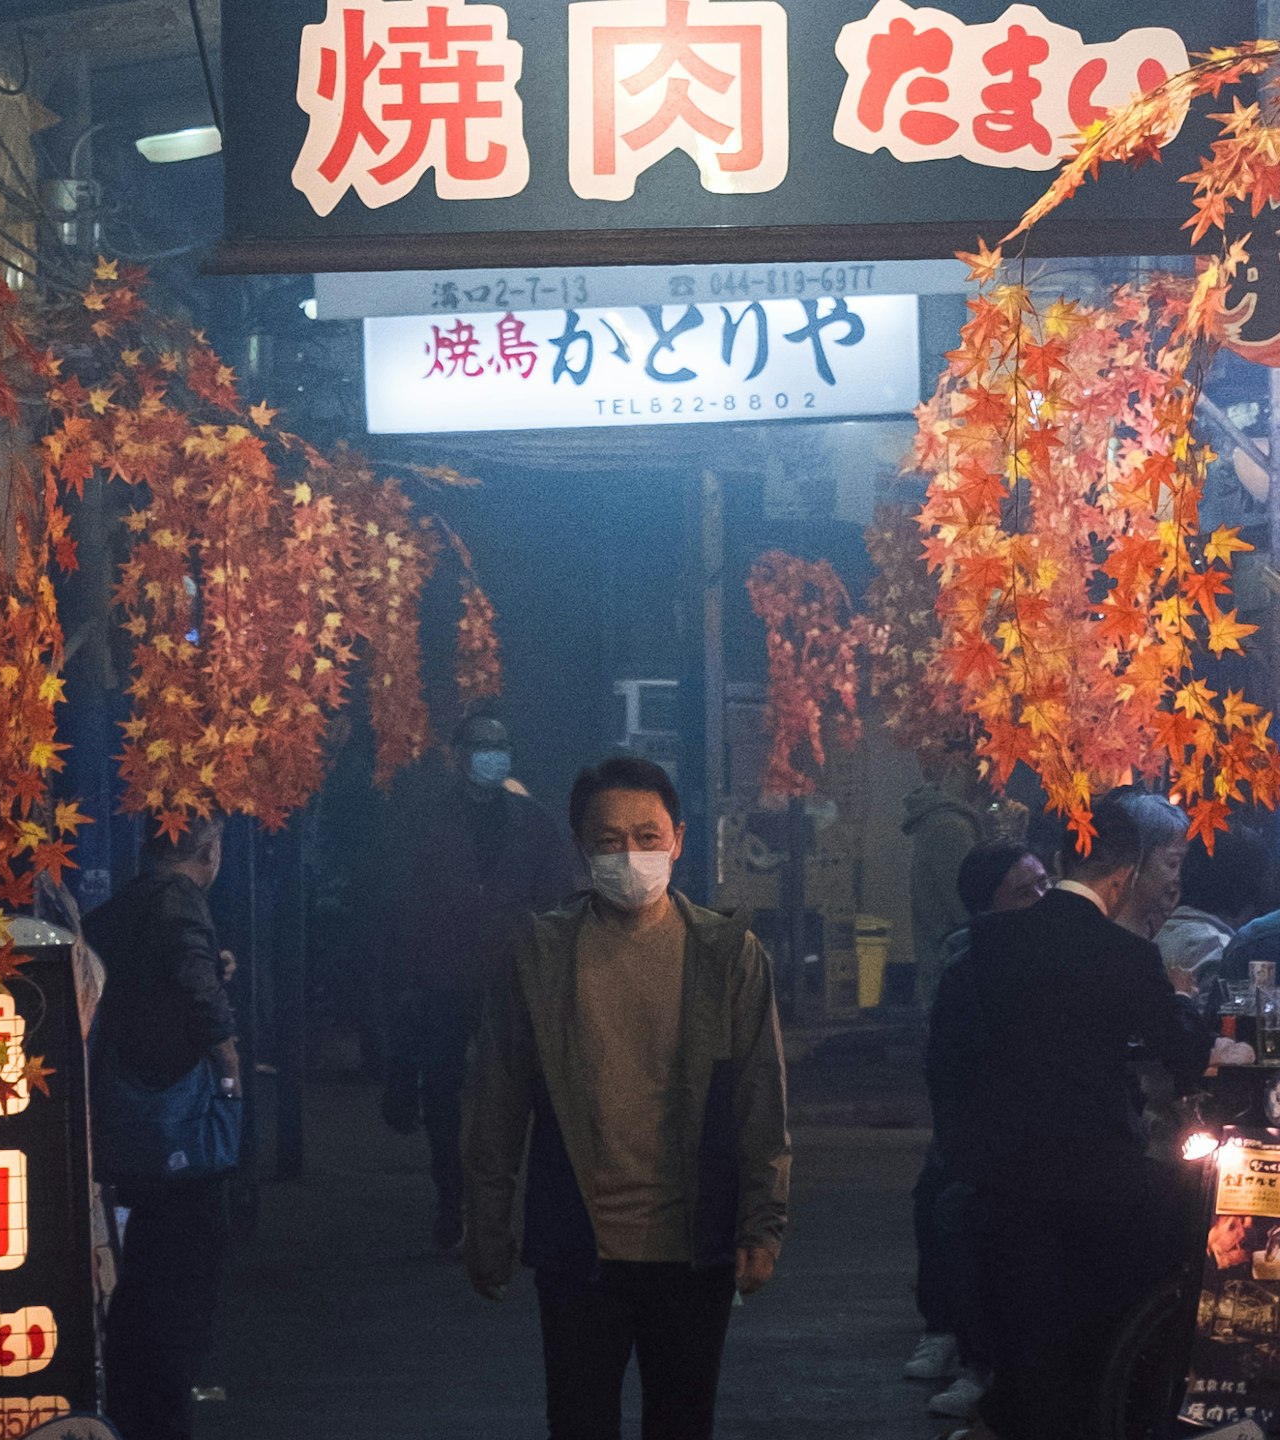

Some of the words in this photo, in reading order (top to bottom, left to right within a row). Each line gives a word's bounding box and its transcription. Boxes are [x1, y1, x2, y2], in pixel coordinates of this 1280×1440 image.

[317, 0, 763, 188] 焼肉
[856, 16, 1166, 156] たまい
[422, 311, 540, 380] 焼鳥
